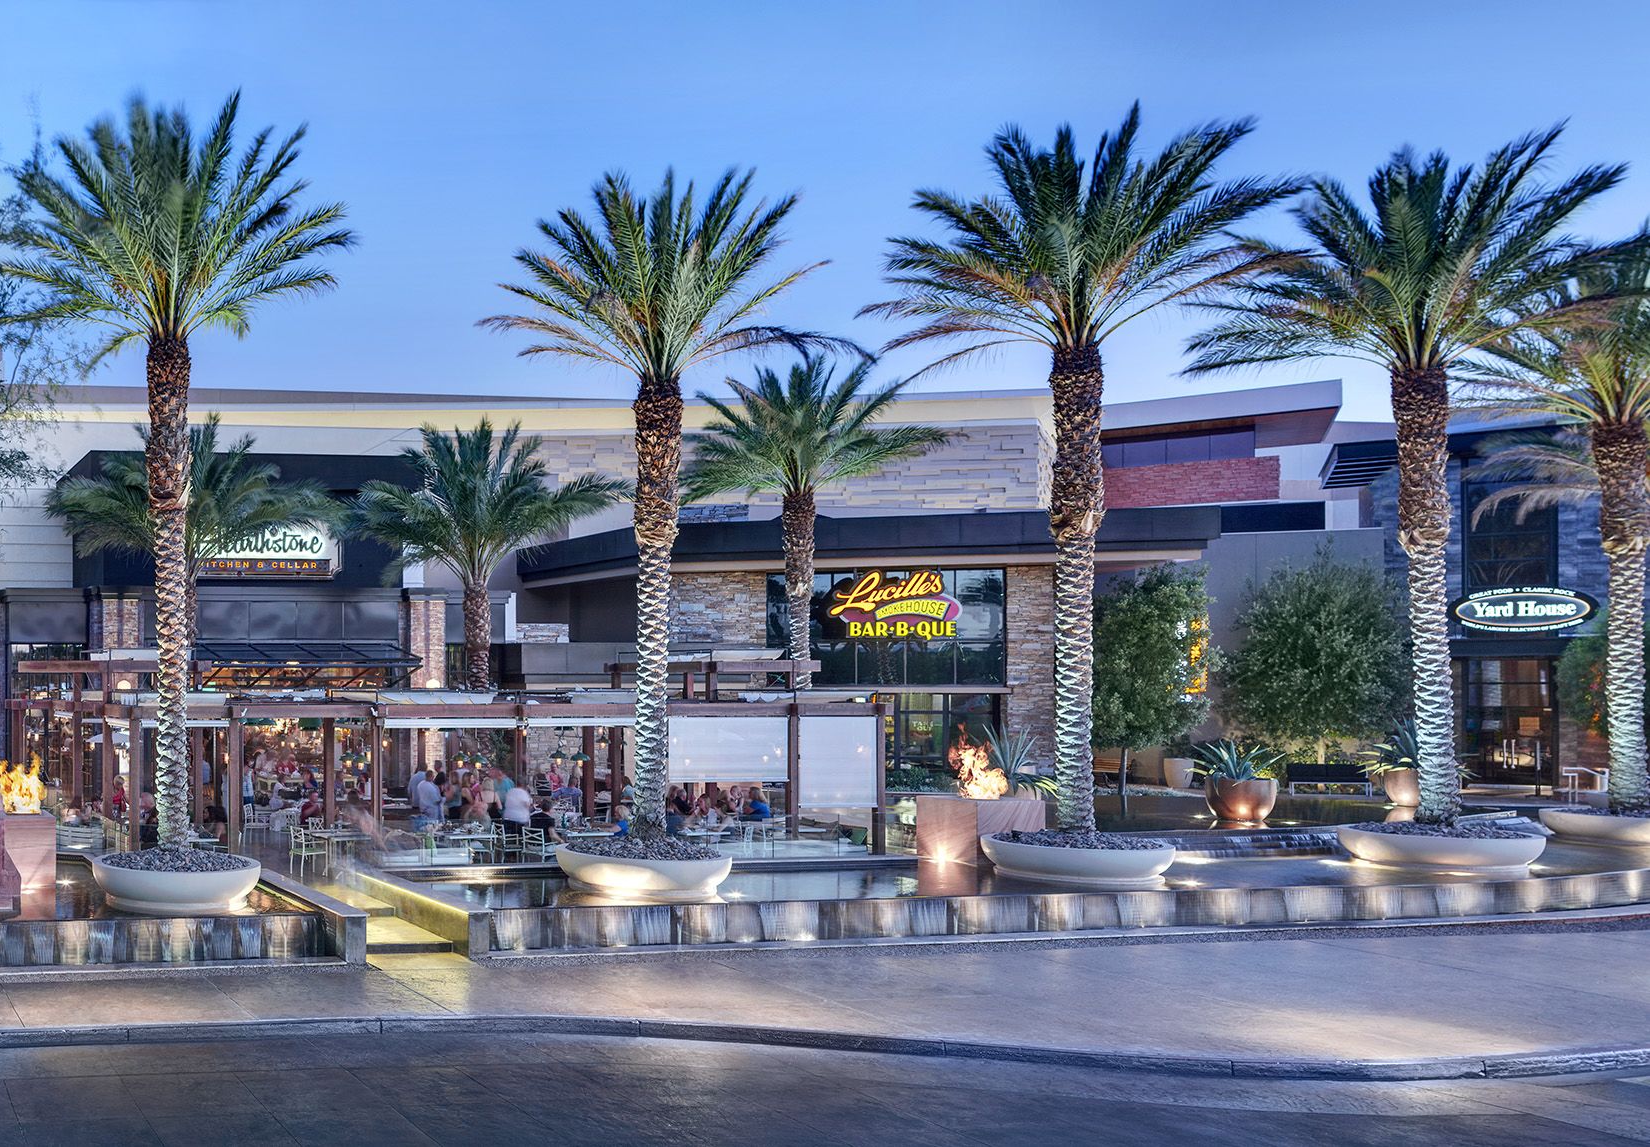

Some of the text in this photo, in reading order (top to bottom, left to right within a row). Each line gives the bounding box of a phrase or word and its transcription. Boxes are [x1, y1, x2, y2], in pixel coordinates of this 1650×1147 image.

[257, 561, 264, 569] &
[272, 561, 317, 569] CELLAR
[830, 571, 943, 616] Lucille's
[1468, 590, 1492, 600] GREAT
[1553, 588, 1576, 597] ROCK
[875, 600, 946, 618] SMOKEHOUSE
[1471, 601, 1577, 617] Yard House
